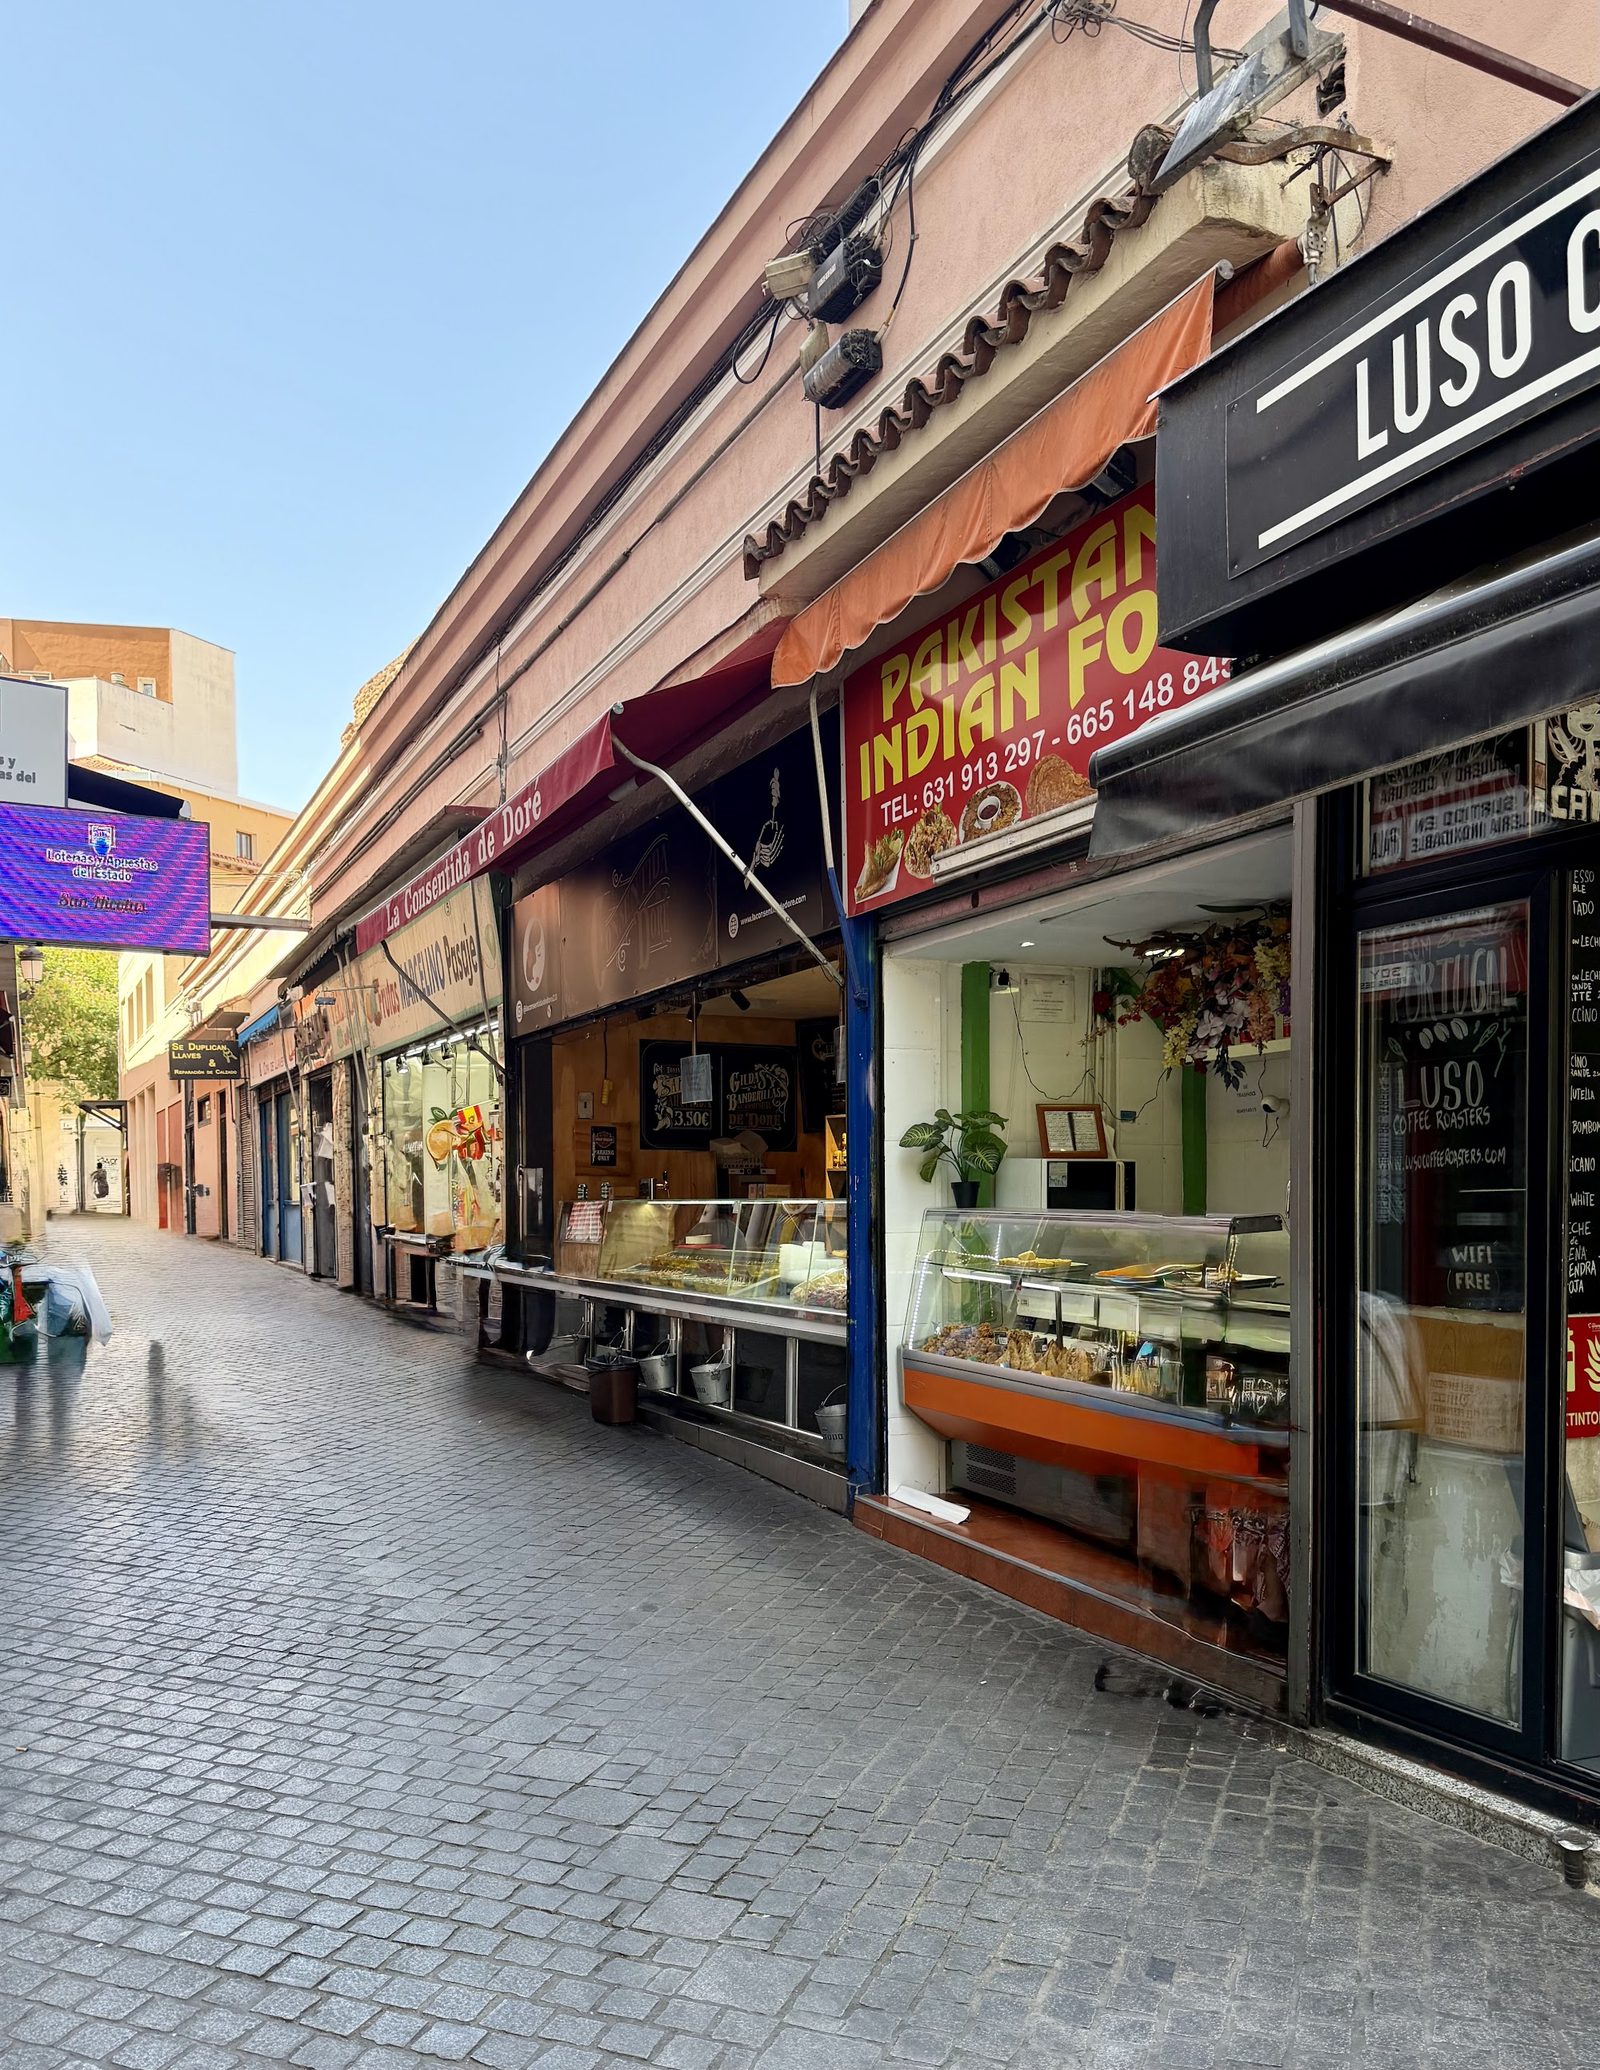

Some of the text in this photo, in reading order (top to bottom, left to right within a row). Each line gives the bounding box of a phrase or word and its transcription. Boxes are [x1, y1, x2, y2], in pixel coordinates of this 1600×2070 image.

[1356, 260, 1532, 461] LUSO
[859, 647, 1041, 801] INDIAN
[880, 789, 918, 827] TEL:
[922, 775, 955, 809] 631
[961, 755, 998, 791] 913
[1004, 730, 1047, 772] 297
[1066, 698, 1115, 745] 665
[1124, 673, 1174, 721] 148
[16, 771, 37, 784] del
[105, 856, 158, 871] Apuestas
[387, 776, 542, 932] La Consentida de Doré
[72, 866, 133, 883] del Estado
[443, 924, 479, 986] Pasaje
[1390, 946, 1518, 1024] PORTUGAL
[208, 1058, 217, 1067] &
[1397, 1060, 1484, 1110] LUSO
[727, 1088, 782, 1111] BANDERILLAS
[674, 1110, 710, 1127] 3.50€
[1392, 1109, 1432, 1136] COFFEE
[1435, 1105, 1491, 1131] ROASTERS
[1451, 1244, 1493, 1265] WIFI
